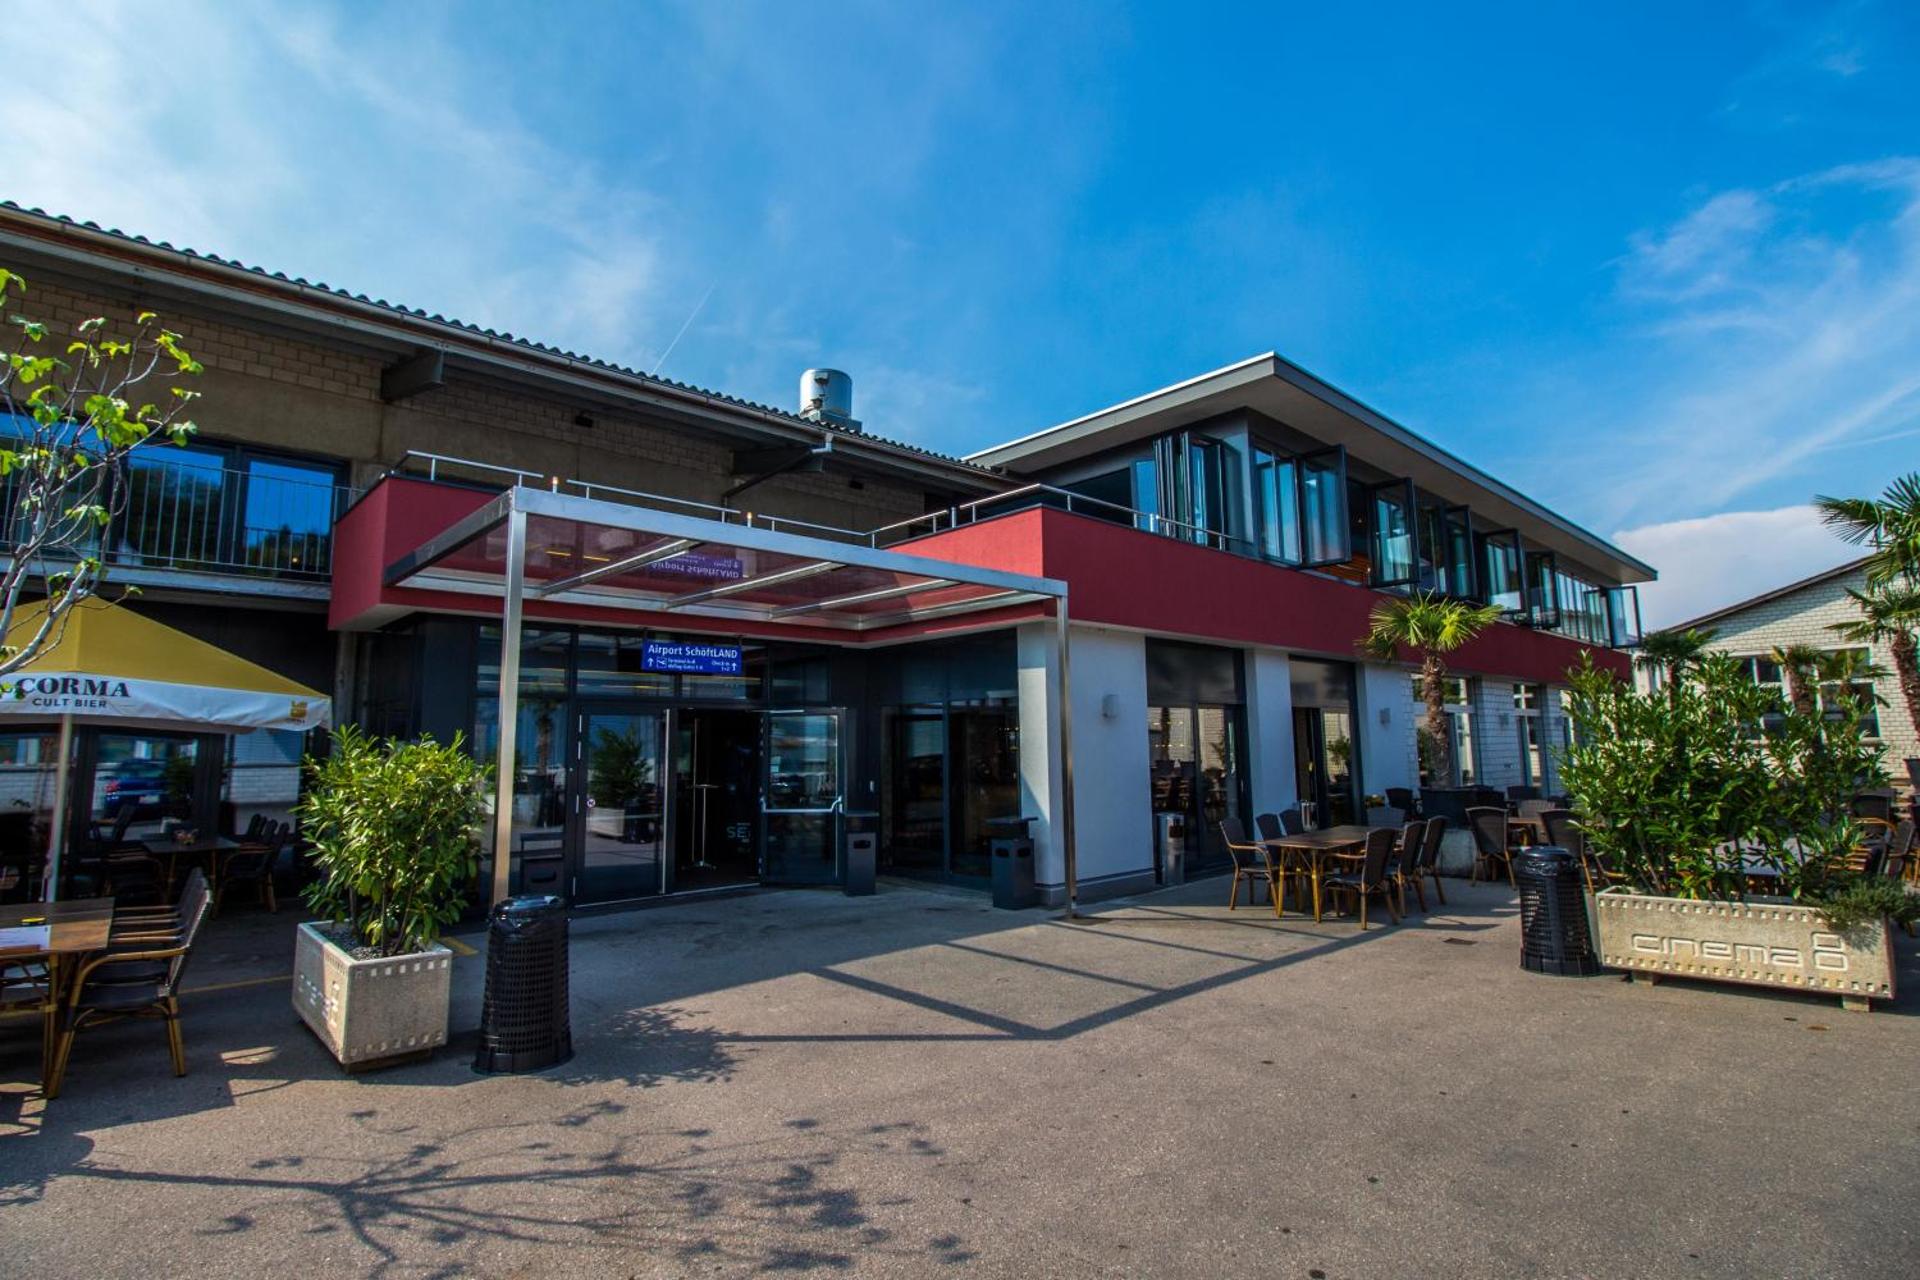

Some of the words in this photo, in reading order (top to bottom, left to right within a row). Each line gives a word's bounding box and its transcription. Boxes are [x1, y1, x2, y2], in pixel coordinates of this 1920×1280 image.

[648, 644, 682, 655] Airport
[685, 647, 738, 658] SchöftLAND
[32, 698, 70, 707] CULT
[75, 698, 108, 708] BIER
[1631, 933, 1803, 968] cinema
[1810, 931, 1848, 972] 8
